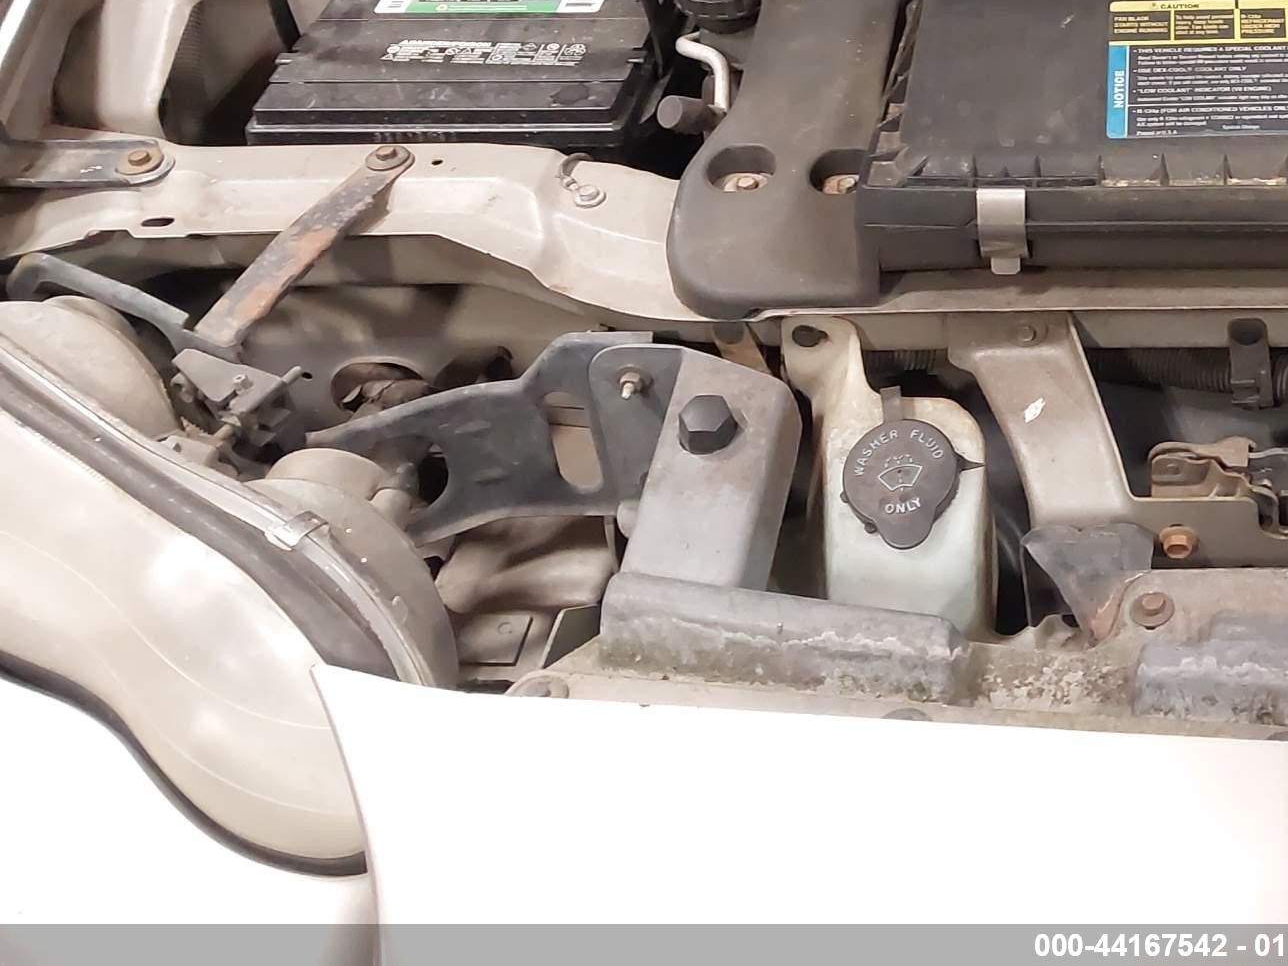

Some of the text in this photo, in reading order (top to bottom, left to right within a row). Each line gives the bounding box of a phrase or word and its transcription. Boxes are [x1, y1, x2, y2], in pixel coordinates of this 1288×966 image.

[1113, 70, 1125, 109] NOTICE
[853, 429, 945, 477] WASHER FLUID
[884, 497, 922, 514] ONLY
